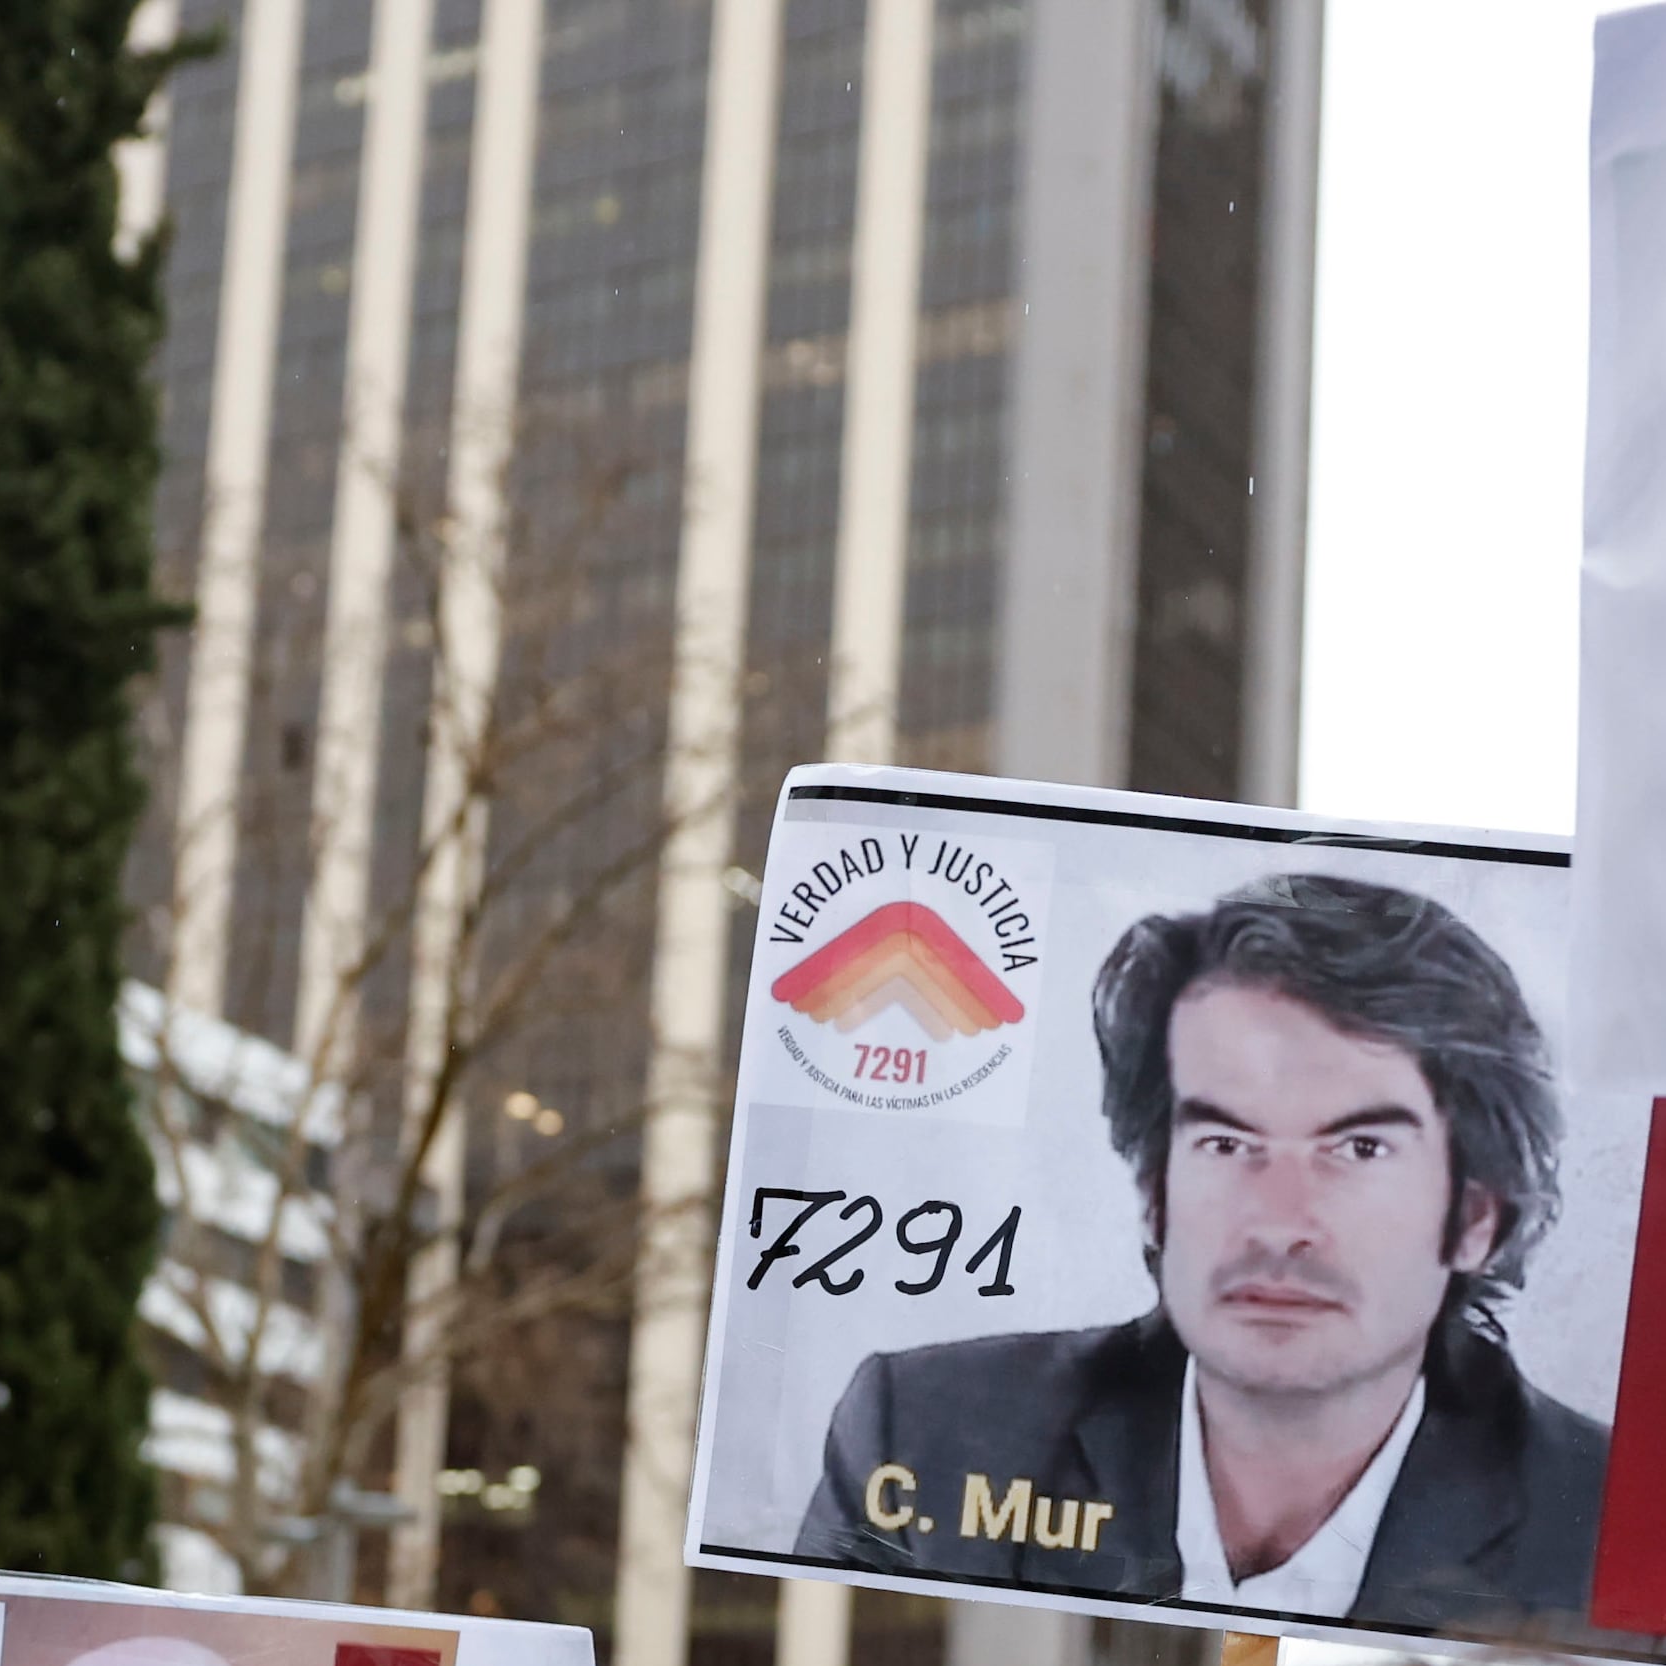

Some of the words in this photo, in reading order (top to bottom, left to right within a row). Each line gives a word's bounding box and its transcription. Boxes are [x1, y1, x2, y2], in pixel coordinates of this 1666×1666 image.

[769, 838, 884, 943] VERDAD
[900, 834, 919, 869] Y
[928, 840, 1038, 972] JUSTICIA
[777, 1025, 803, 1062] VERDAD
[805, 1065, 840, 1095] JUSTICIA
[839, 1085, 863, 1104] PARA
[865, 1094, 883, 1109] LAS
[932, 1091, 943, 1106] EN
[943, 1084, 963, 1101] LAS
[962, 1043, 1013, 1090] RESIDENCIAS
[854, 1044, 928, 1084] 7291
[746, 1187, 1021, 1298] 7291
[864, 1463, 933, 1535] C.
[960, 1474, 1114, 1554] Mur
